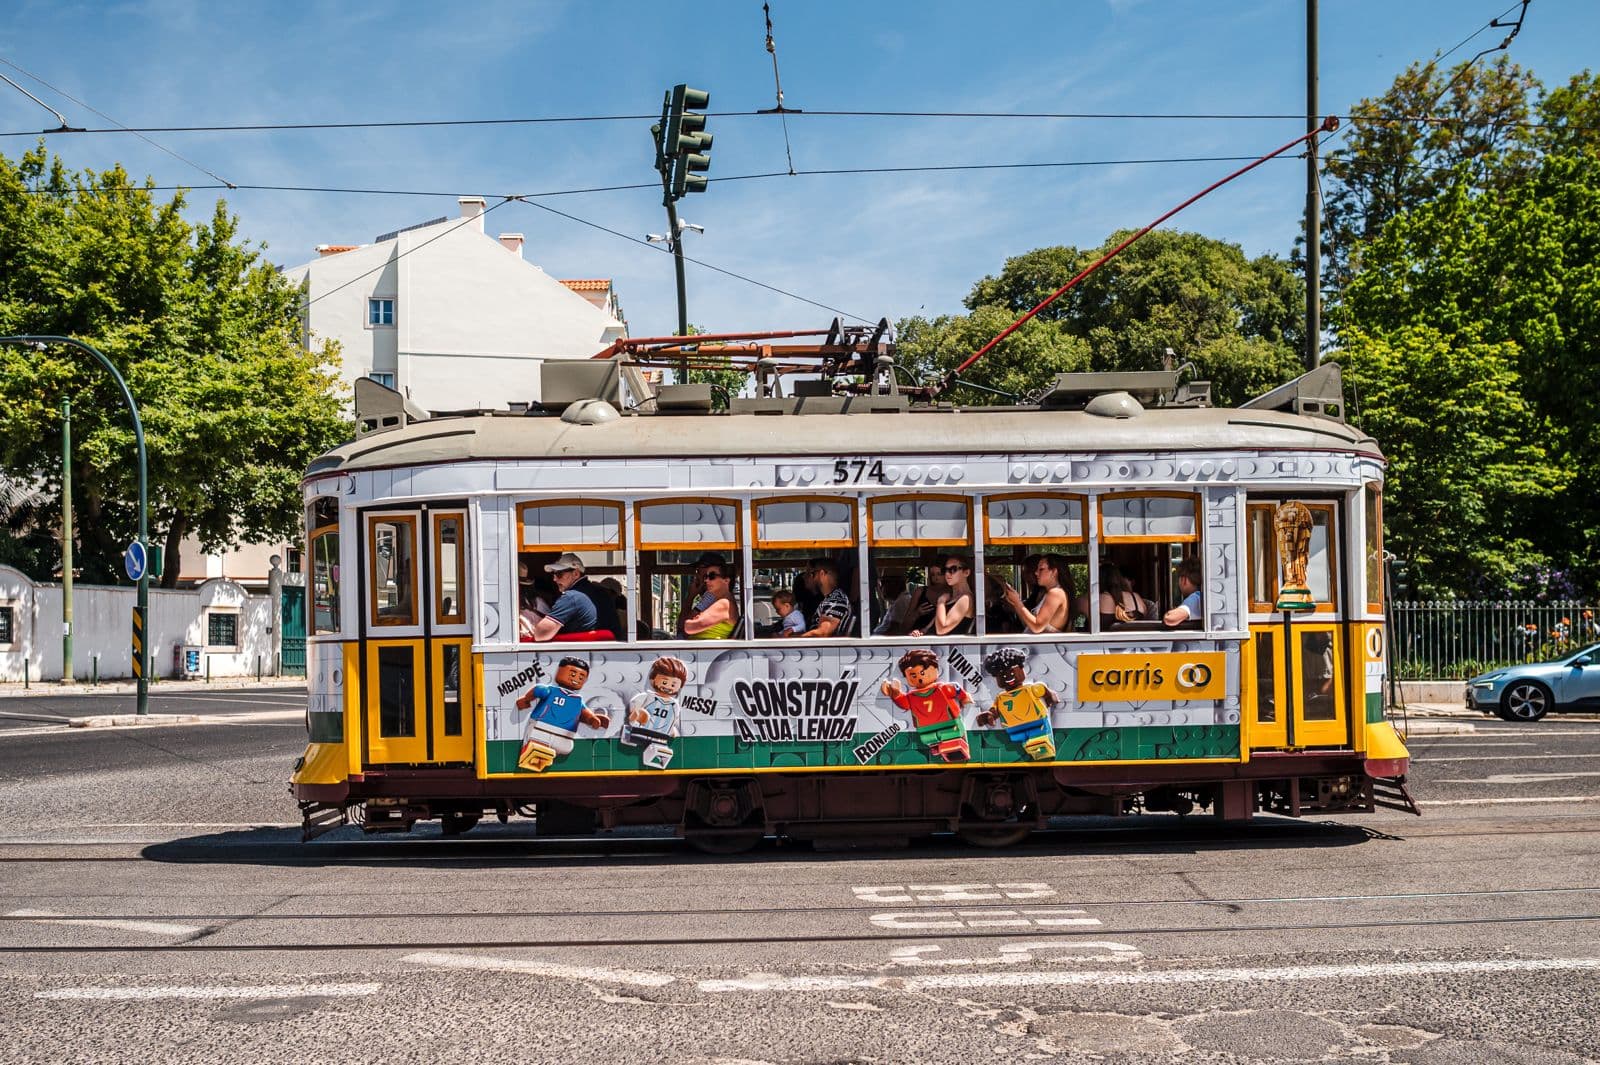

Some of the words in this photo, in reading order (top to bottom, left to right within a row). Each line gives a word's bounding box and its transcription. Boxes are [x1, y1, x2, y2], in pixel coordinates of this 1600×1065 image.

[833, 460, 885, 483] 574
[497, 660, 546, 697] MBAPPÉ
[947, 648, 973, 677] VINI
[968, 671, 983, 687] JR
[1091, 663, 1164, 686] carris
[553, 696, 565, 706] 10
[735, 671, 859, 717] CONSTRÓI
[1003, 700, 1014, 711] 7
[653, 708, 669, 718] 10
[681, 696, 718, 716] MESSI
[923, 700, 933, 712] 7
[736, 718, 757, 741] A
[754, 718, 793, 741] TUA
[797, 718, 858, 741] LENDA
[854, 723, 901, 764] RONALDO
